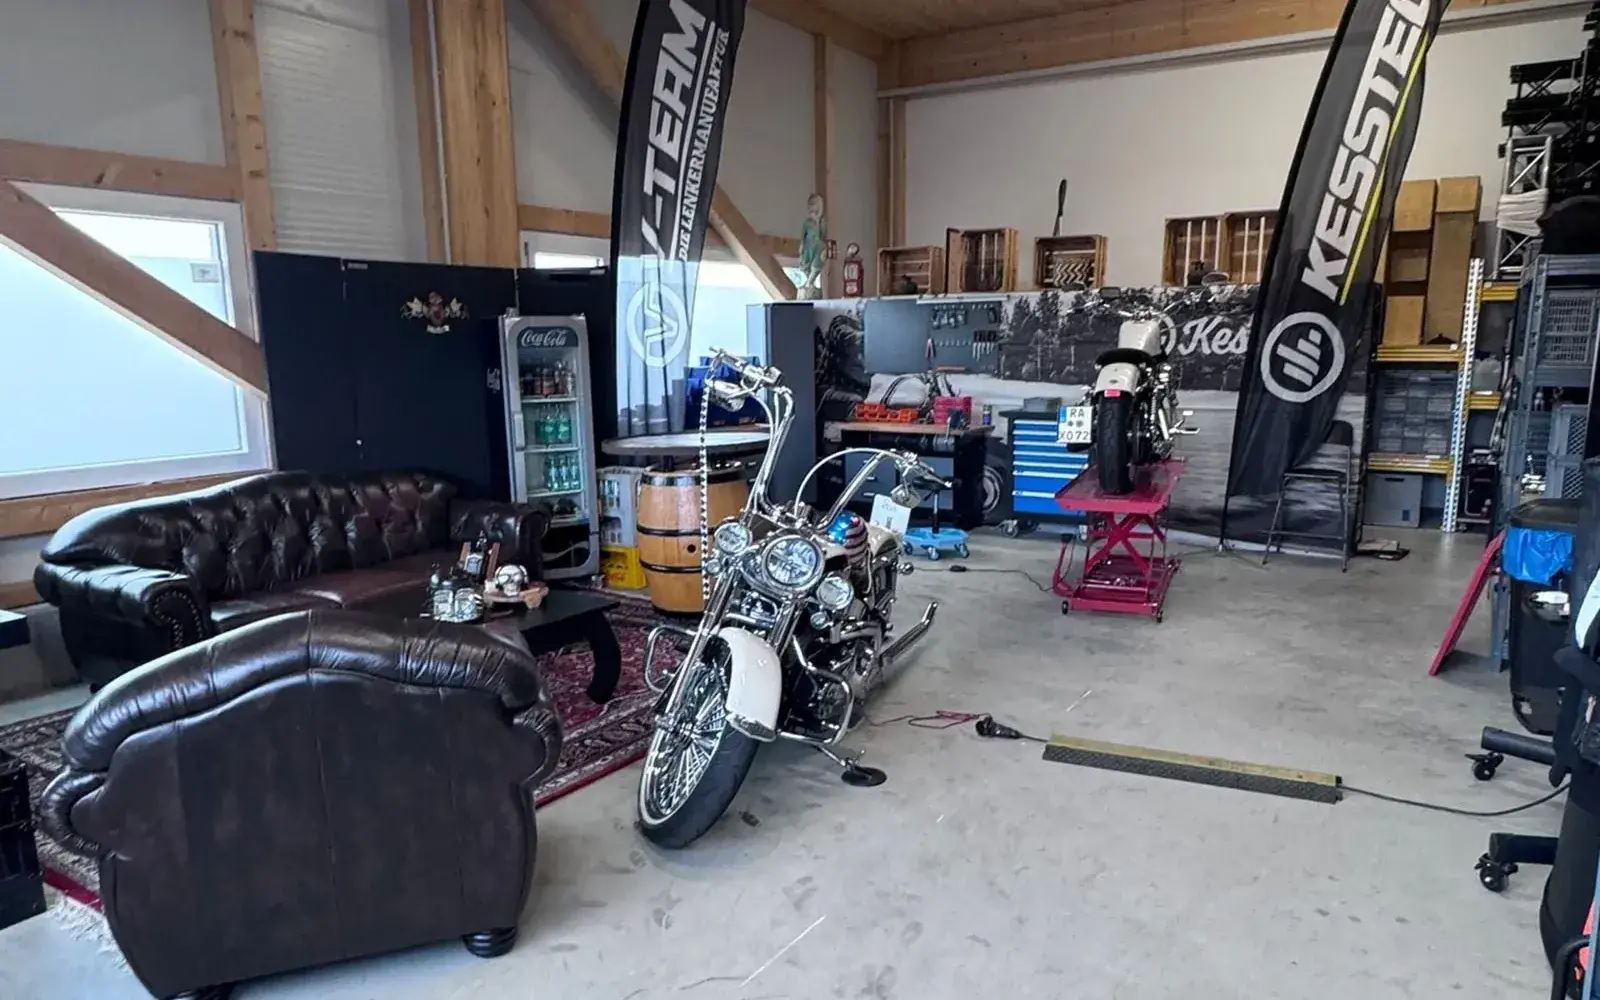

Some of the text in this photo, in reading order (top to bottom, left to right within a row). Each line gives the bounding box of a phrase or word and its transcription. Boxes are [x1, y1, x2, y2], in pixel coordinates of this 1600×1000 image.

[679, 230, 691, 263] DIE
[521, 329, 567, 346] CocaCola
[1178, 313, 1253, 355] Kes
[1070, 408, 1085, 418] RA
